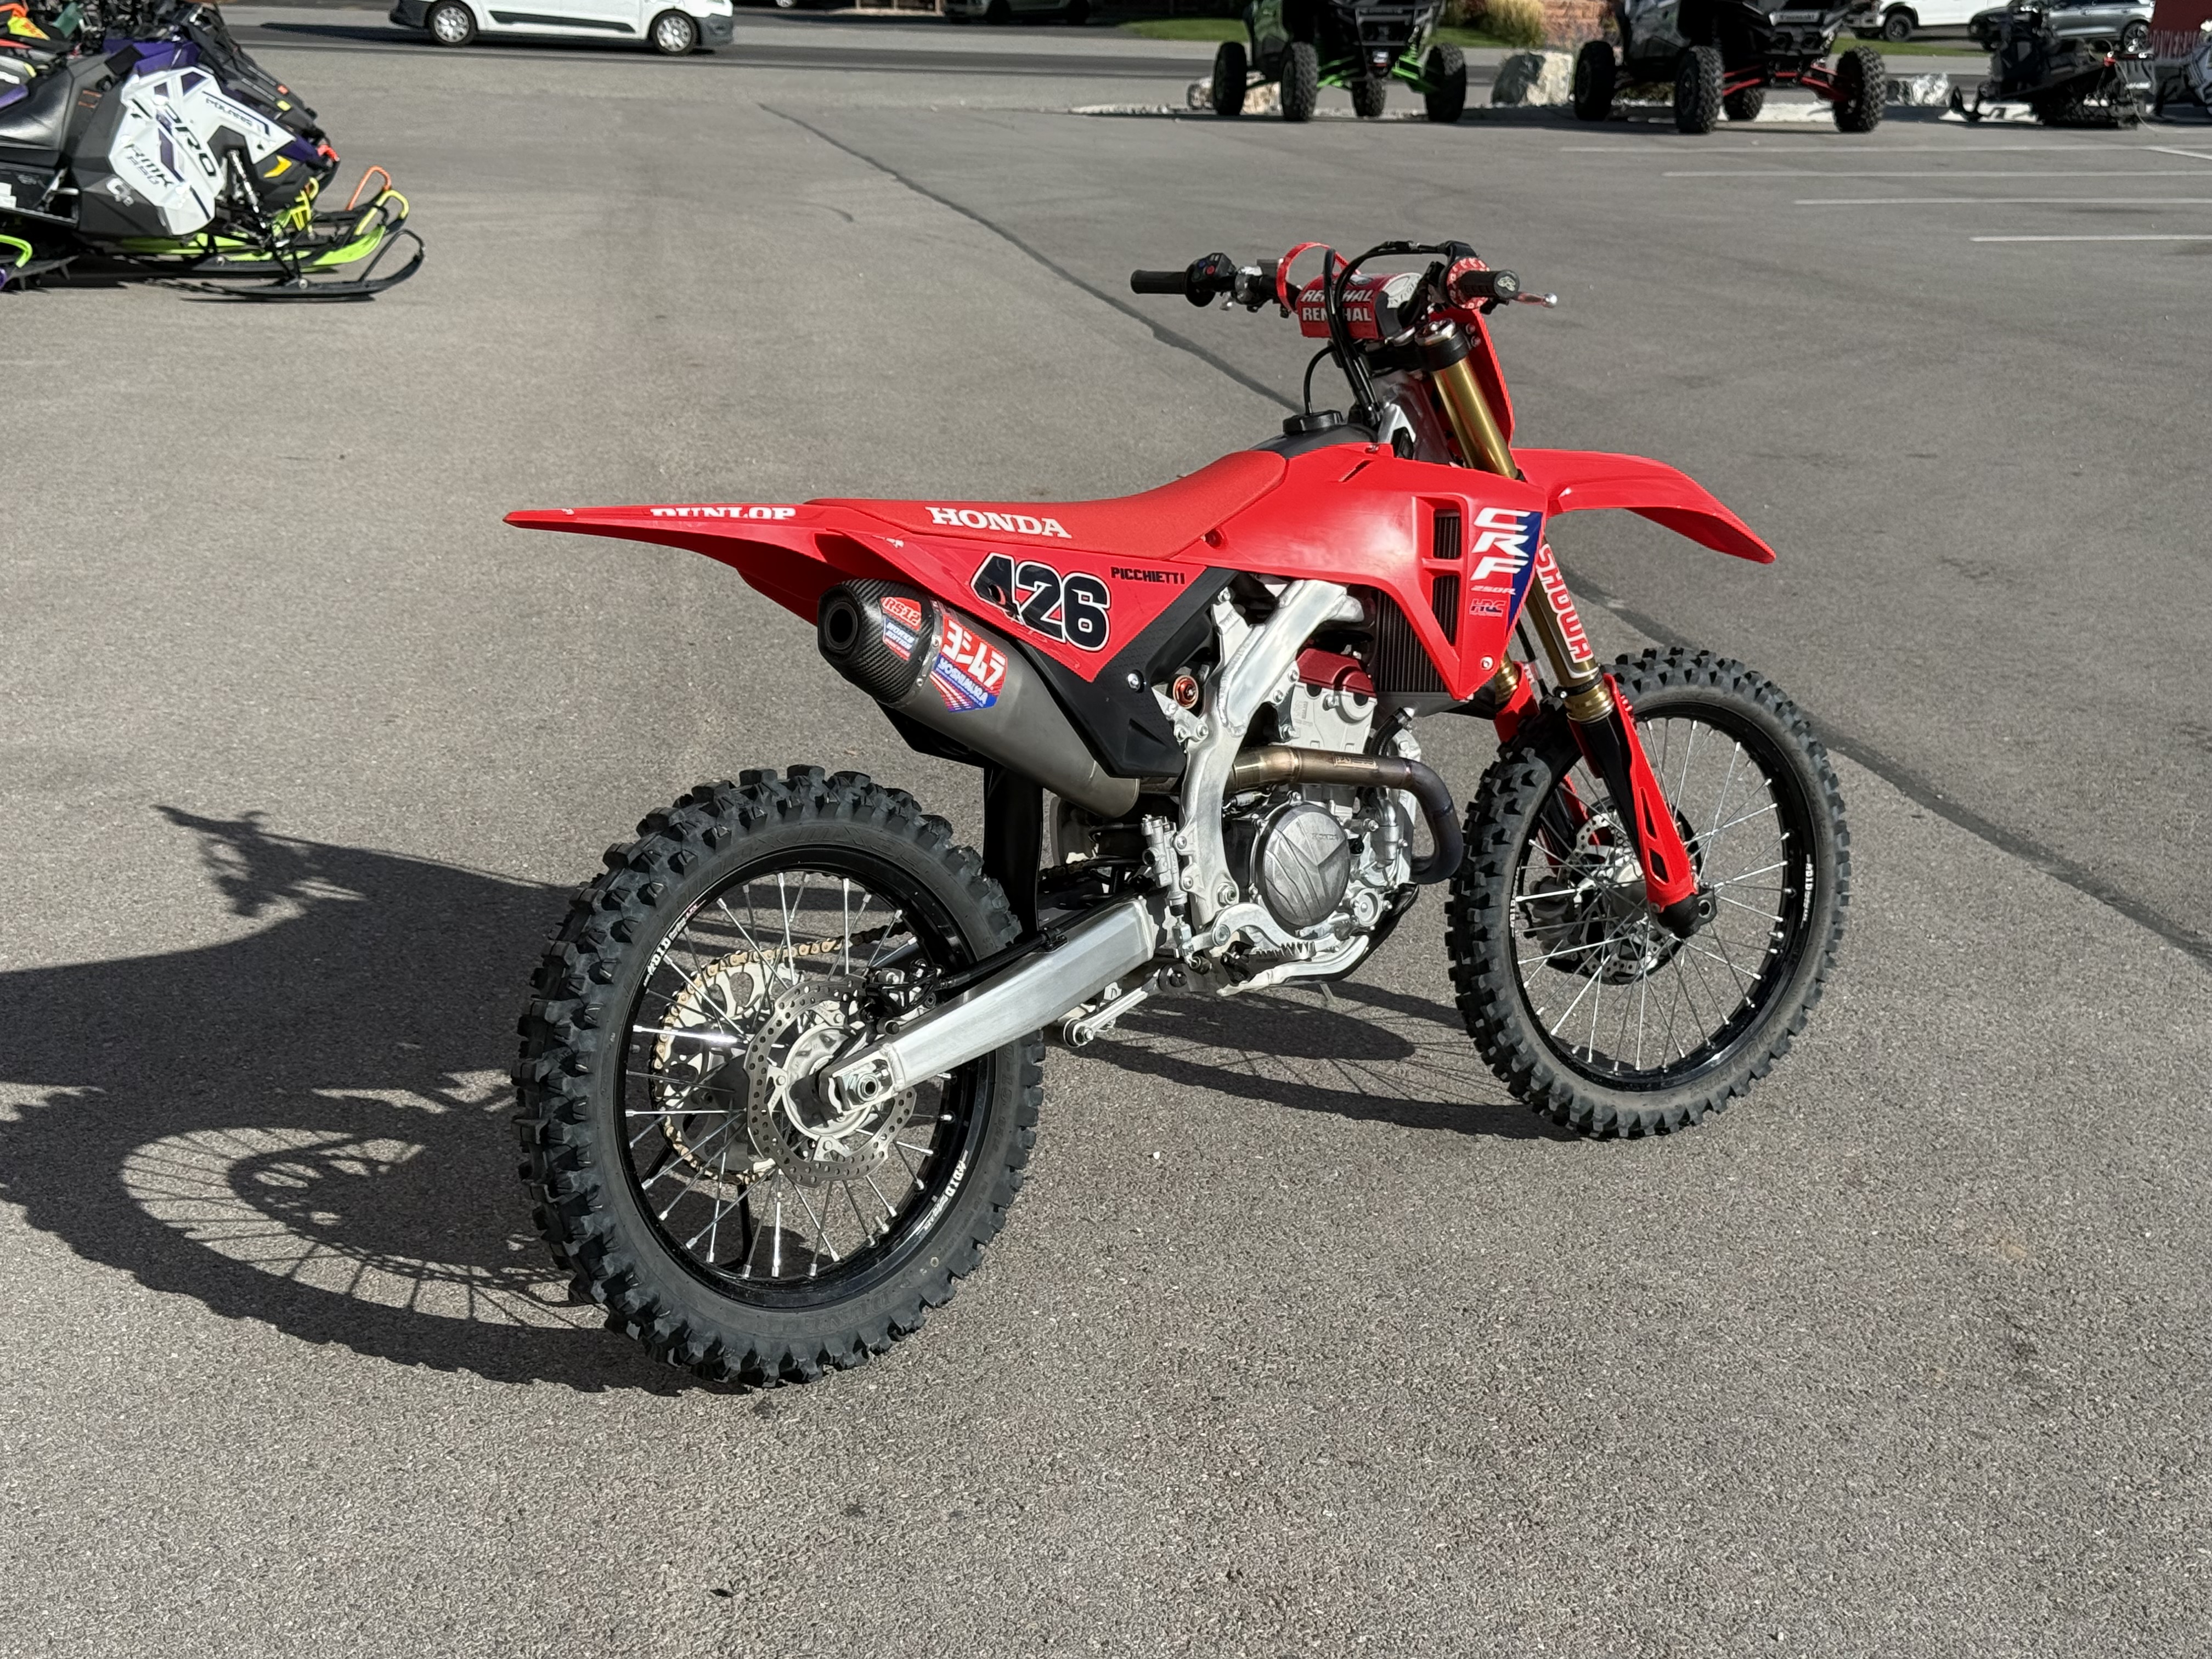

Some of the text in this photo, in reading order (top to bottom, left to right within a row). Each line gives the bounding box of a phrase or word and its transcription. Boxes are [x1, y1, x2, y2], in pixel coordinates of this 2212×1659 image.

[650, 506, 796, 520] DUNLOP
[925, 506, 1073, 539] HONDA
[1470, 507, 1531, 581] CRF
[1110, 566, 1186, 585] PICCHIETTI
[1471, 585, 1516, 595] 250R
[970, 552, 1111, 652] 426
[1536, 543, 1594, 664] SHOWA
[937, 658, 989, 705] YOSHIMURA
